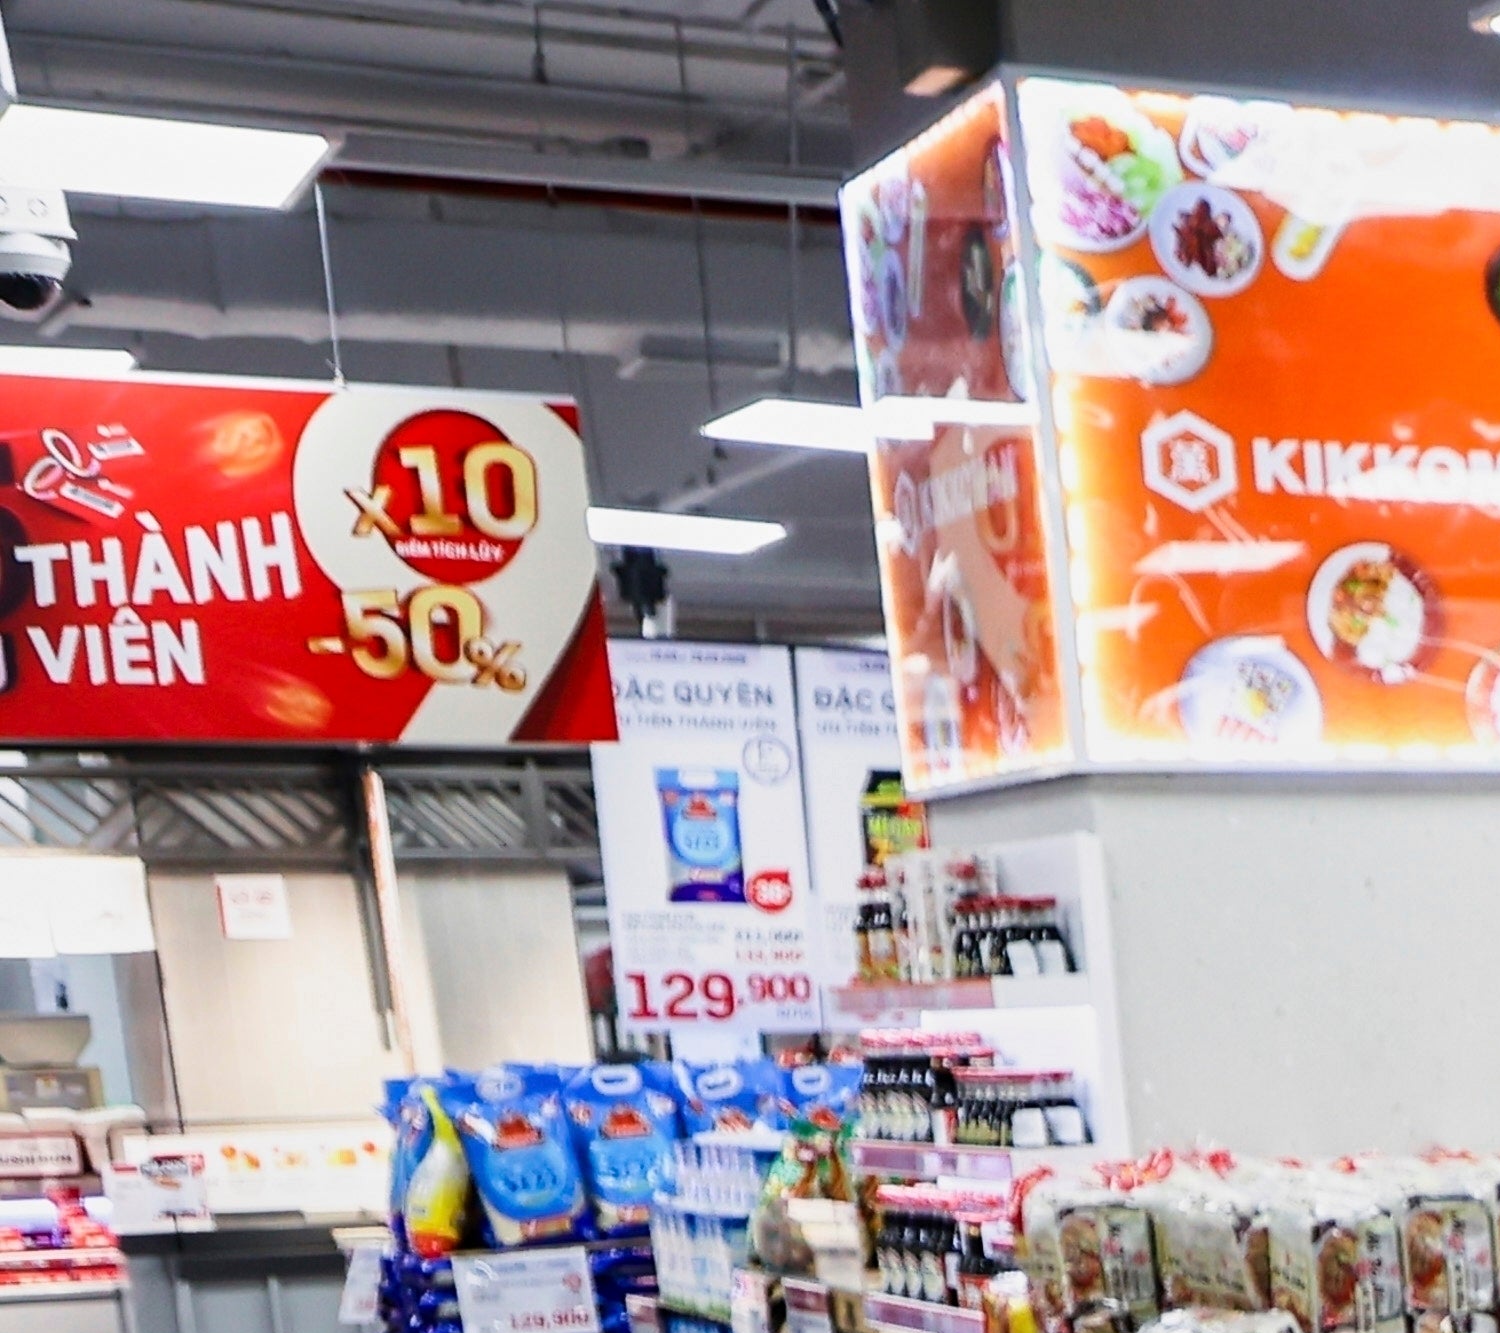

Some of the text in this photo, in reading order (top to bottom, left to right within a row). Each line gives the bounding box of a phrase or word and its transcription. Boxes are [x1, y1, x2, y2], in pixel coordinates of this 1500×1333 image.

[343, 442, 539, 539] x10
[14, 510, 301, 608] THÀNH
[28, 616, 205, 687] VIÊN
[307, 584, 527, 692] -50%
